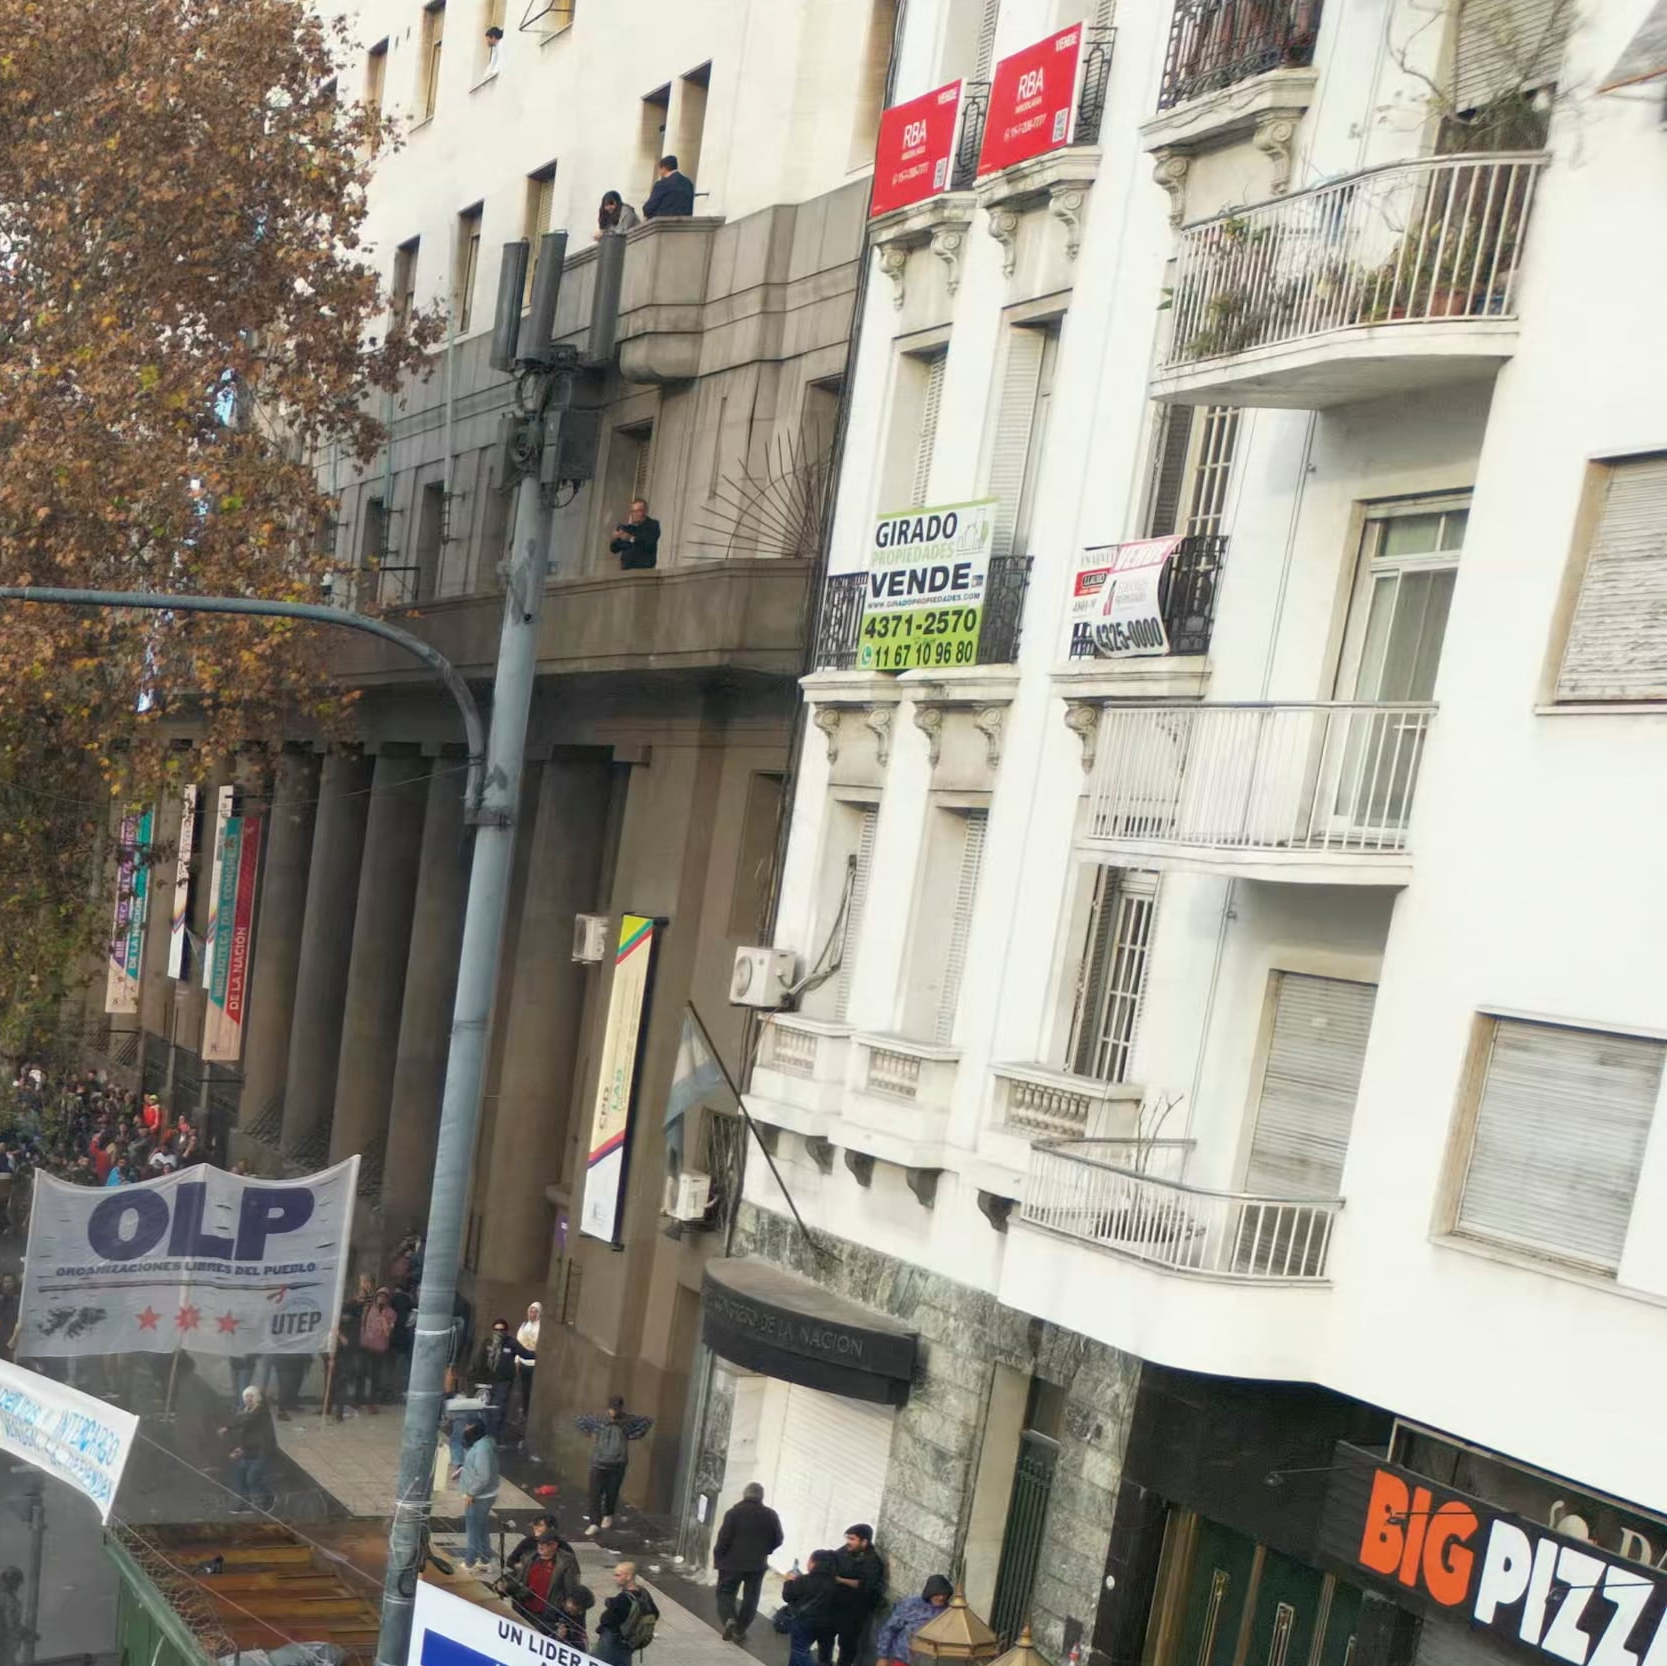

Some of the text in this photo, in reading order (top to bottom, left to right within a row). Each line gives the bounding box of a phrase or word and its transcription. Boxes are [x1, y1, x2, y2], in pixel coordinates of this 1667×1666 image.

[1017, 67, 1044, 101] RBA
[902, 119, 928, 149] RBA
[875, 512, 958, 548] GIRADO
[872, 542, 956, 566] PROPIEDADES
[871, 562, 972, 598] VENDE
[865, 608, 978, 639] 4371-2570
[88, 1181, 315, 1261] OLP
[56, 1261, 317, 1277] ORGANIZACIONES LIBRES DEL PUEBLO
[271, 1311, 322, 1336] UTEP
[1359, 1468, 1479, 1607] BIG
[497, 1619, 523, 1648] UN
